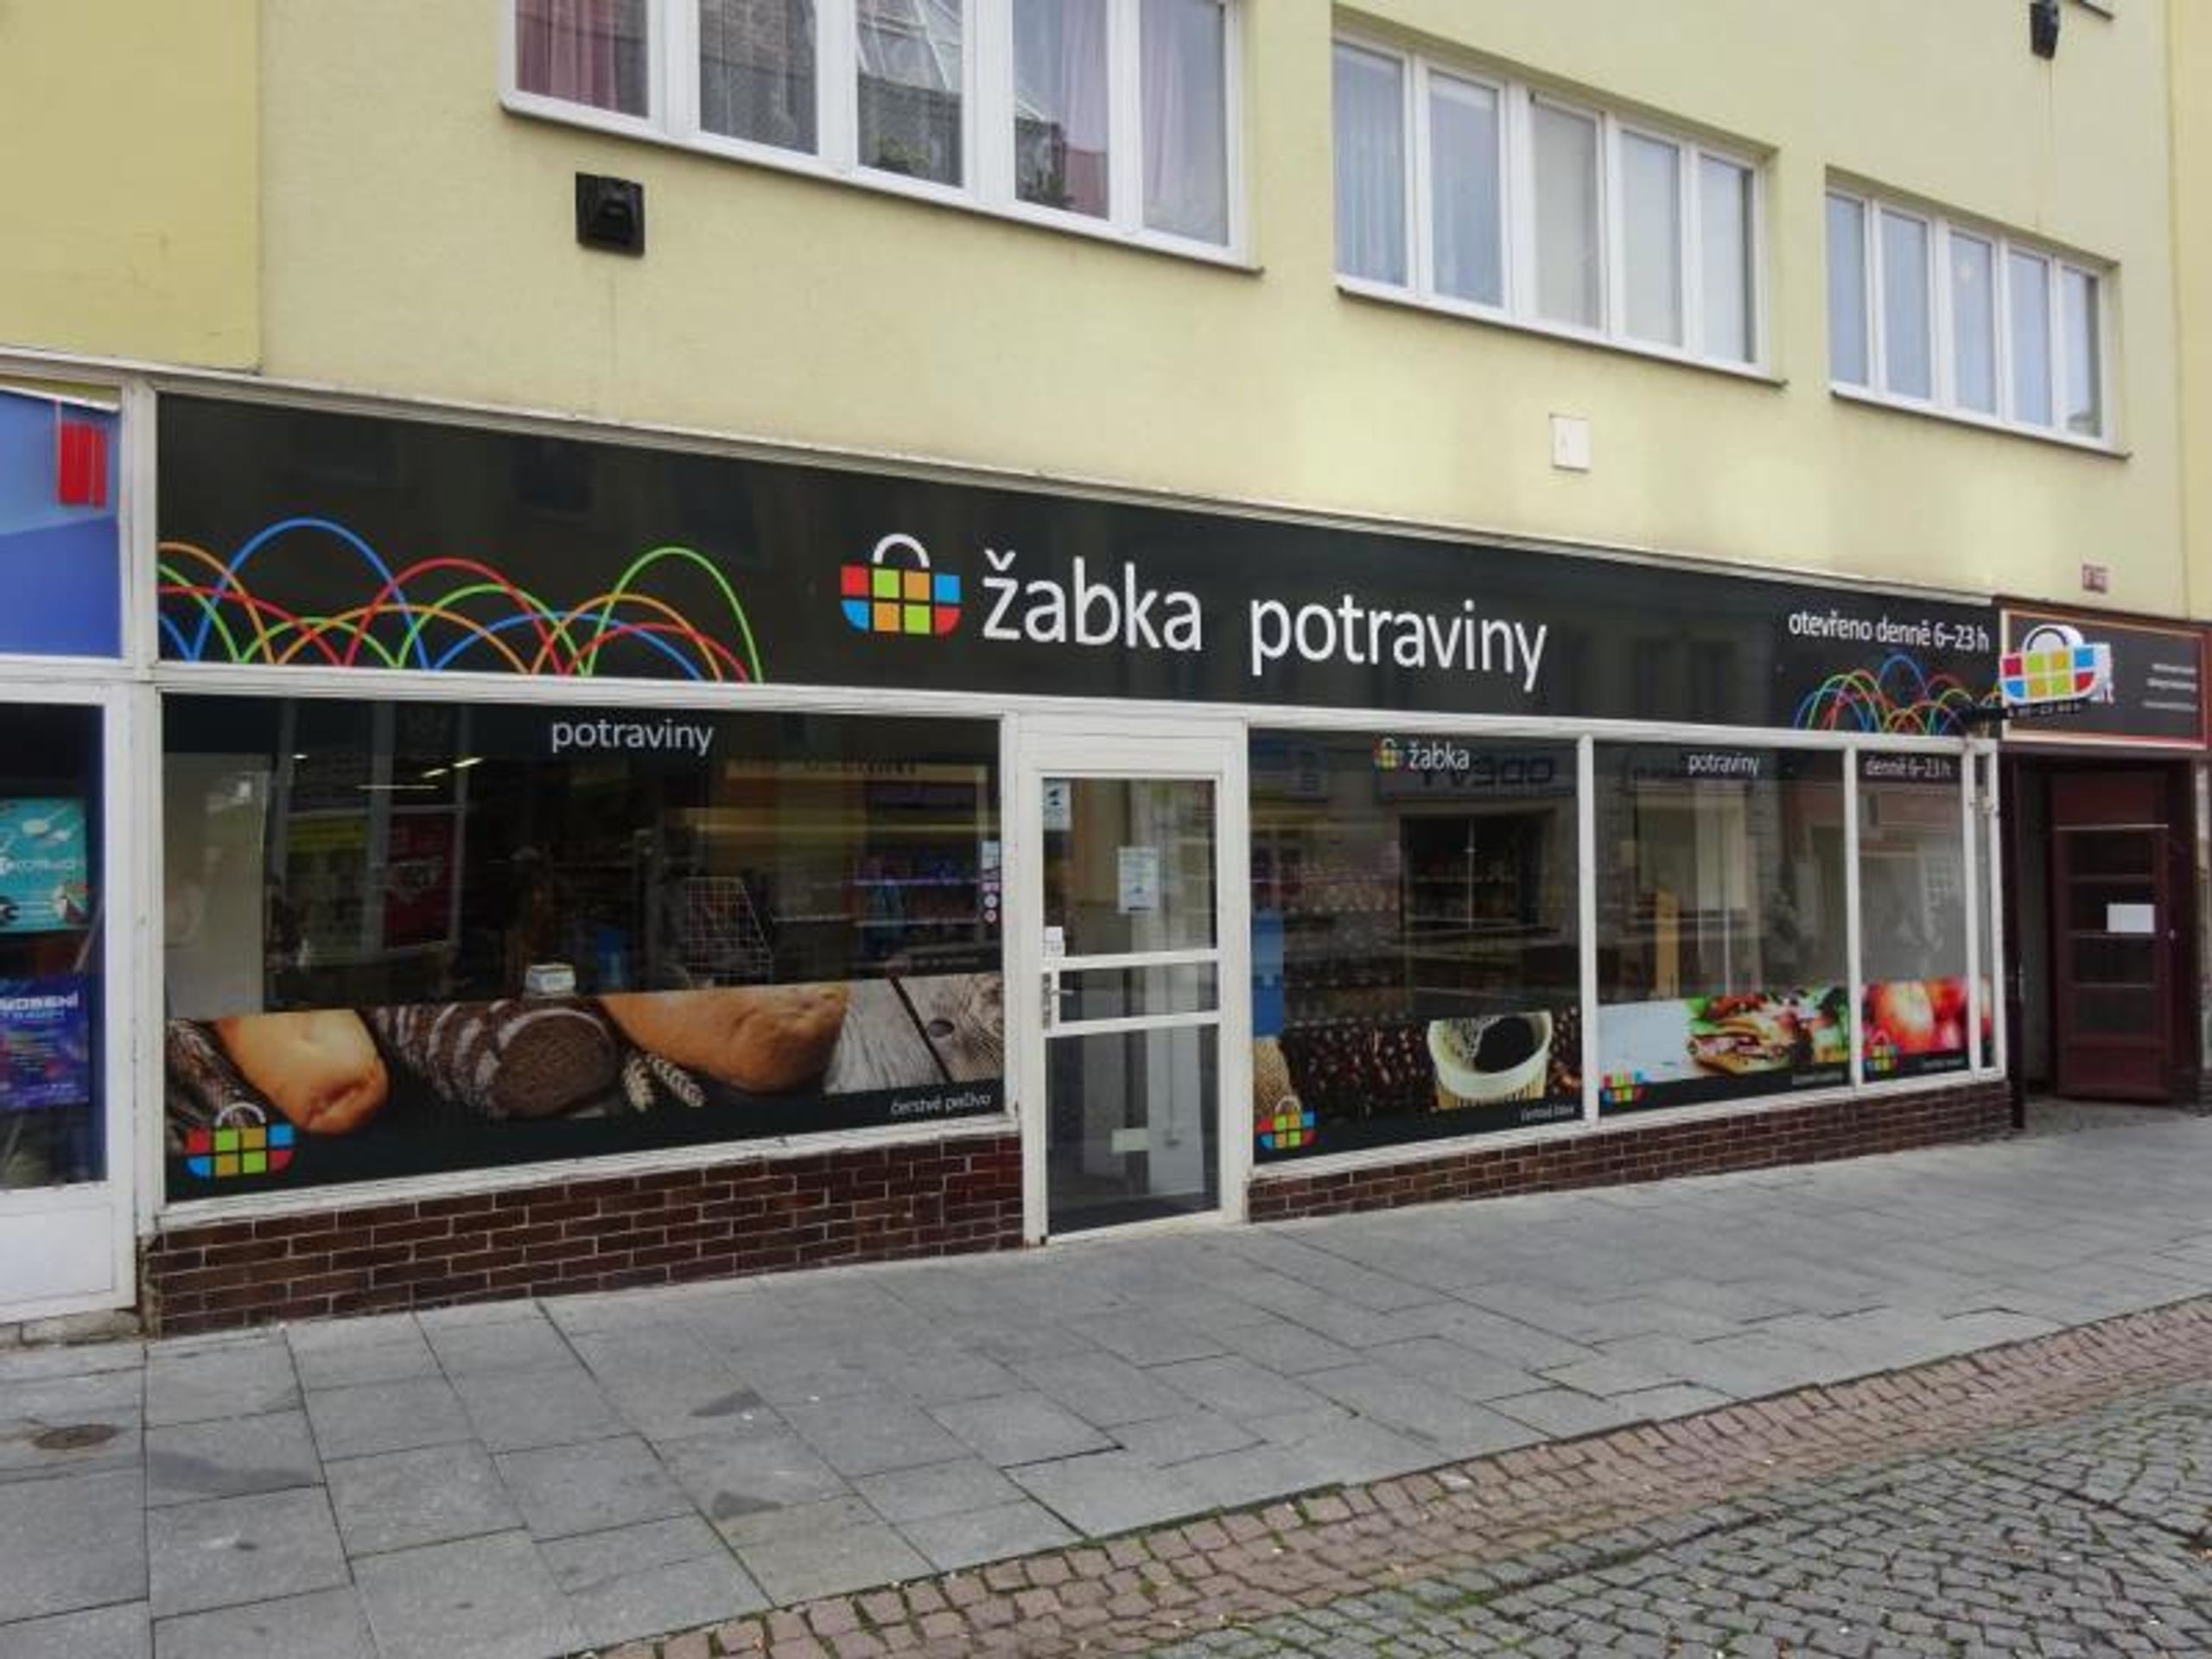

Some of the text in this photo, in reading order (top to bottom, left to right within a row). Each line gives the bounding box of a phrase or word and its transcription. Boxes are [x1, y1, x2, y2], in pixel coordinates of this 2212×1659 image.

[982, 549, 1548, 693] žabka potraviny
[1788, 608, 1873, 641] otevřeno
[1876, 613, 1931, 646] denně
[551, 718, 715, 756] potraviny
[1408, 740, 1470, 770] žabka
[1688, 752, 1760, 776] potraviny
